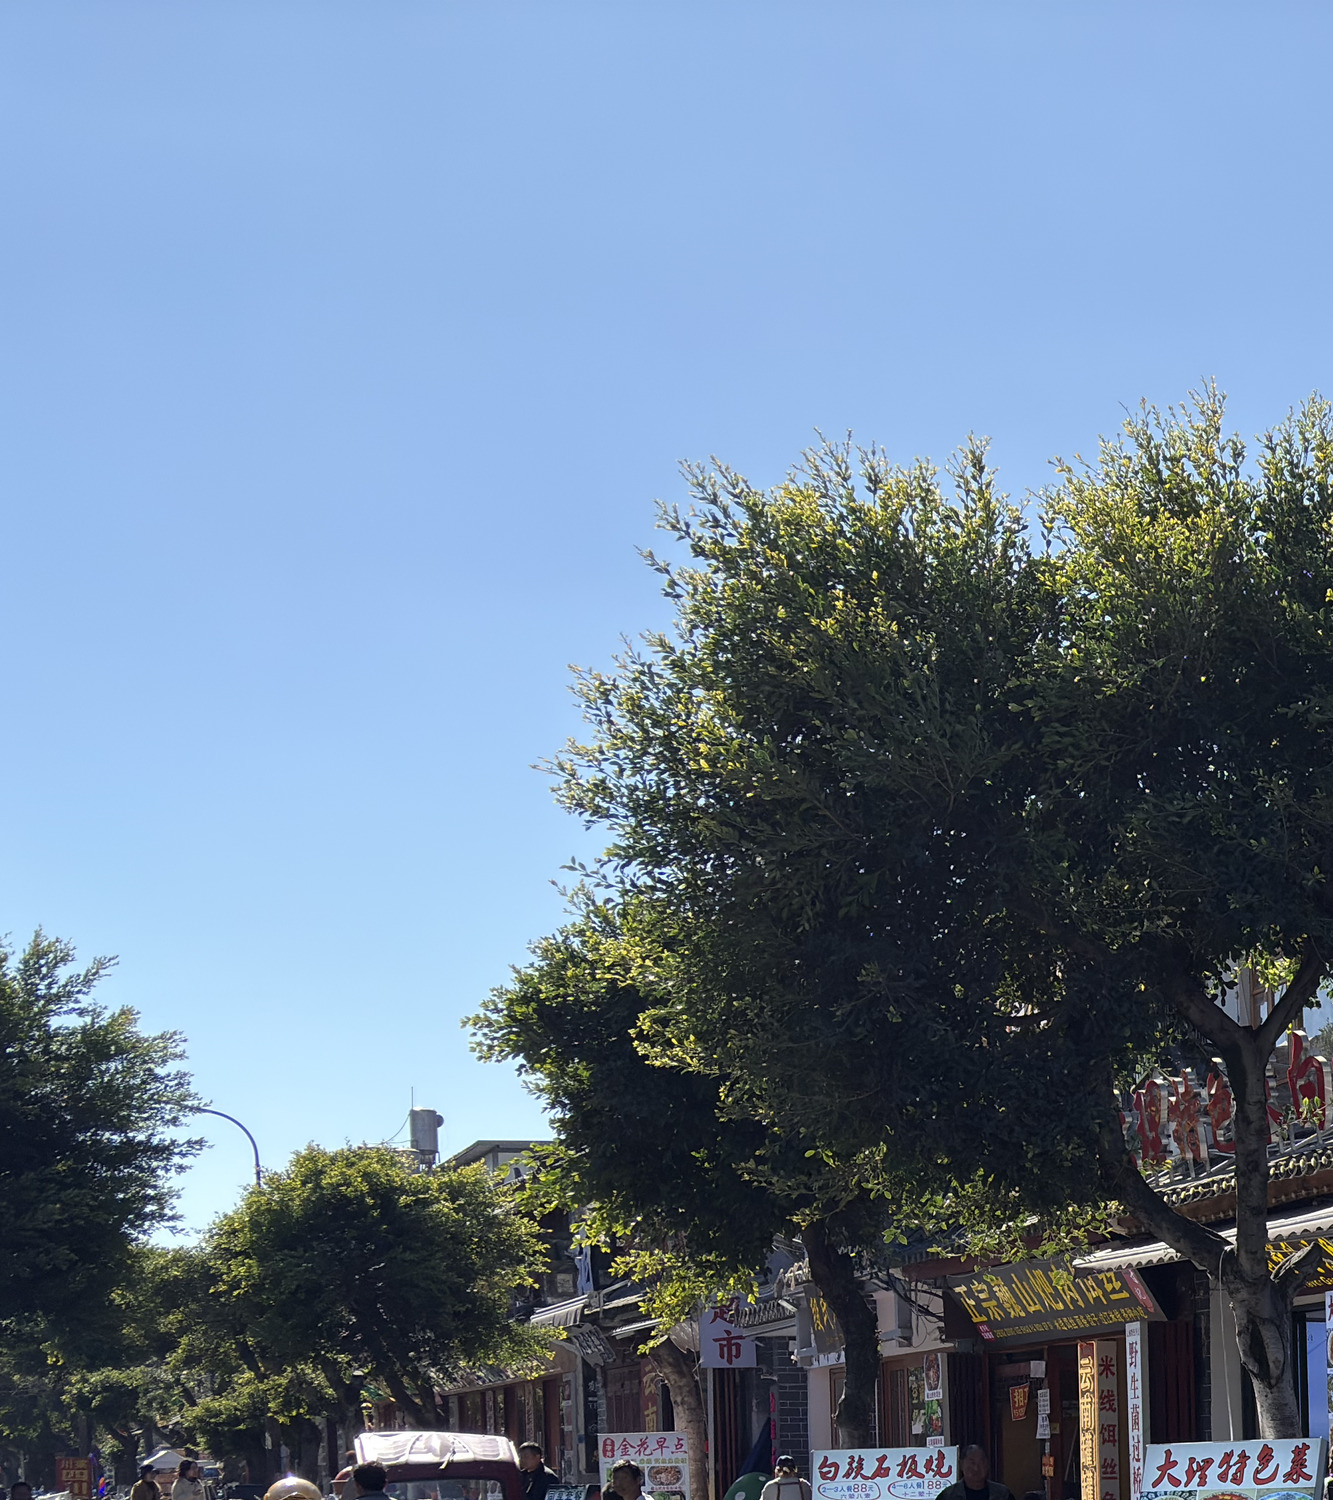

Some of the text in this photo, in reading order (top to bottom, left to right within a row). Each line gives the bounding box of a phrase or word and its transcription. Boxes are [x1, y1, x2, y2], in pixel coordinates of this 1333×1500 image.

[616, 1436, 688, 1457] 金花早点
[818, 1450, 953, 1482] 白族石板烧
[1152, 1442, 1313, 1489] 大理特色菜
